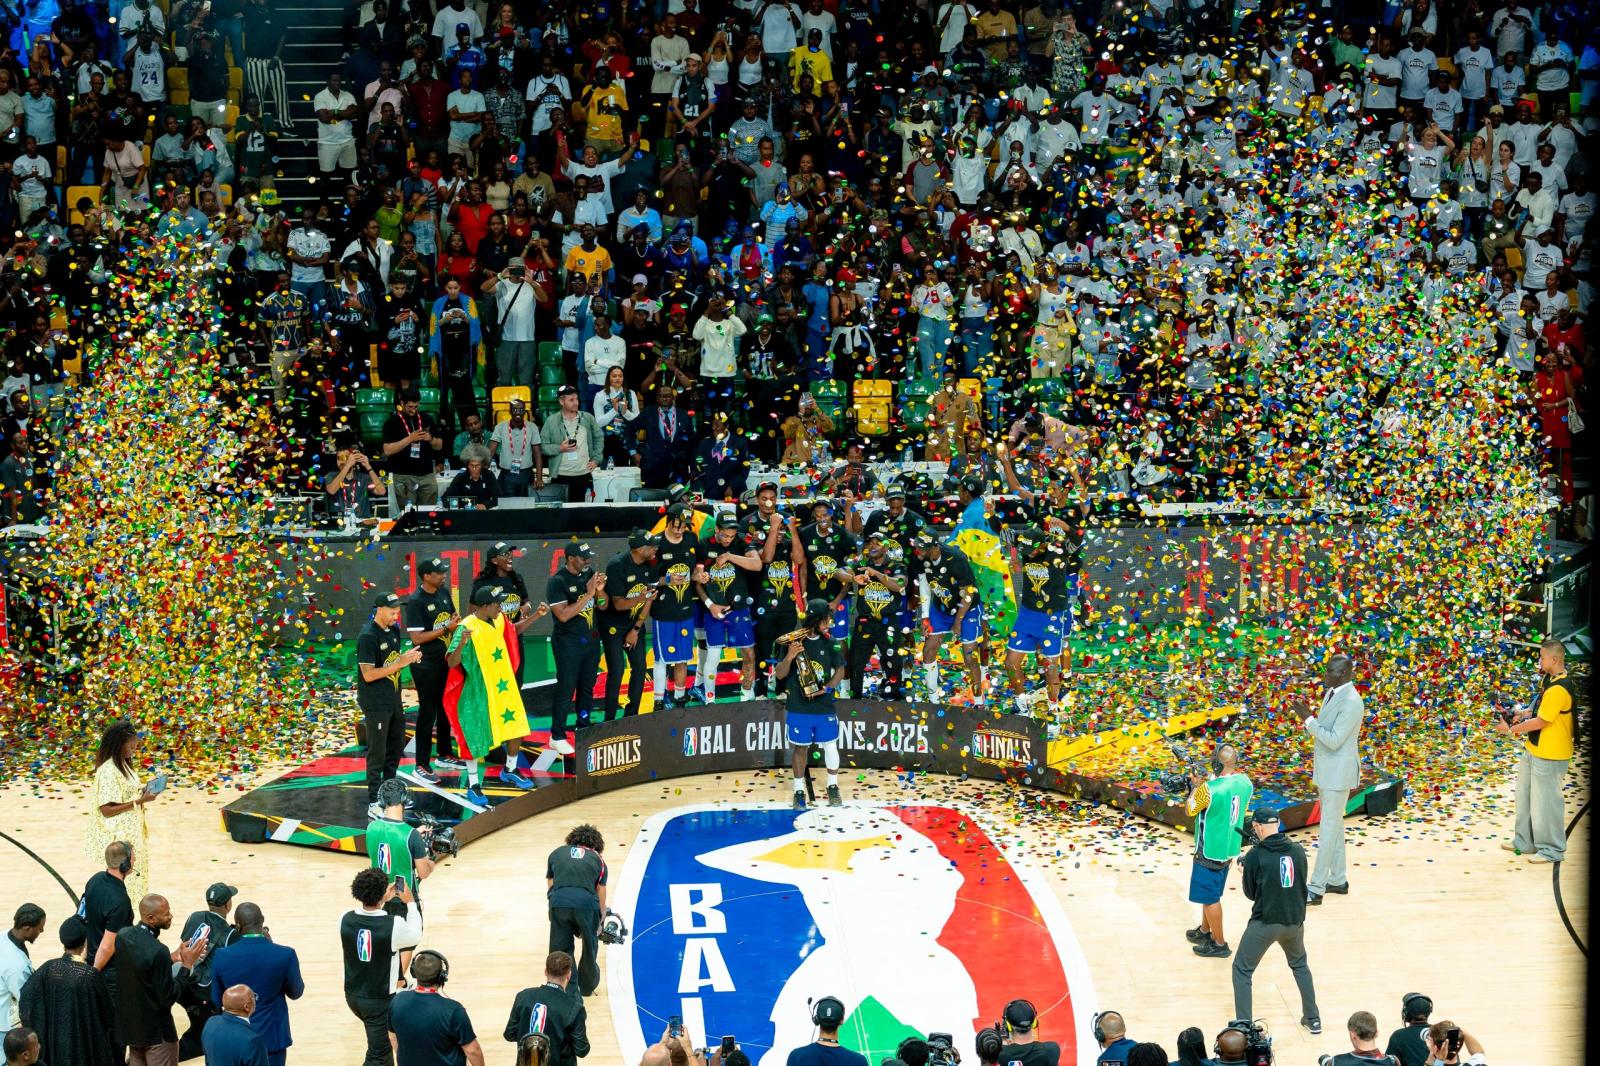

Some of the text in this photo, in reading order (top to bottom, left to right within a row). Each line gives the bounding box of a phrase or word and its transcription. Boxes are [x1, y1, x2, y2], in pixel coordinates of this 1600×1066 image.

[141, 71, 158, 84] 24
[246, 129, 265, 152] 12
[700, 721, 928, 755] BAL CHANS 2025
[983, 735, 1031, 764] FINALS
[597, 739, 641, 769] FINALS
[669, 883, 737, 1054] BAL
